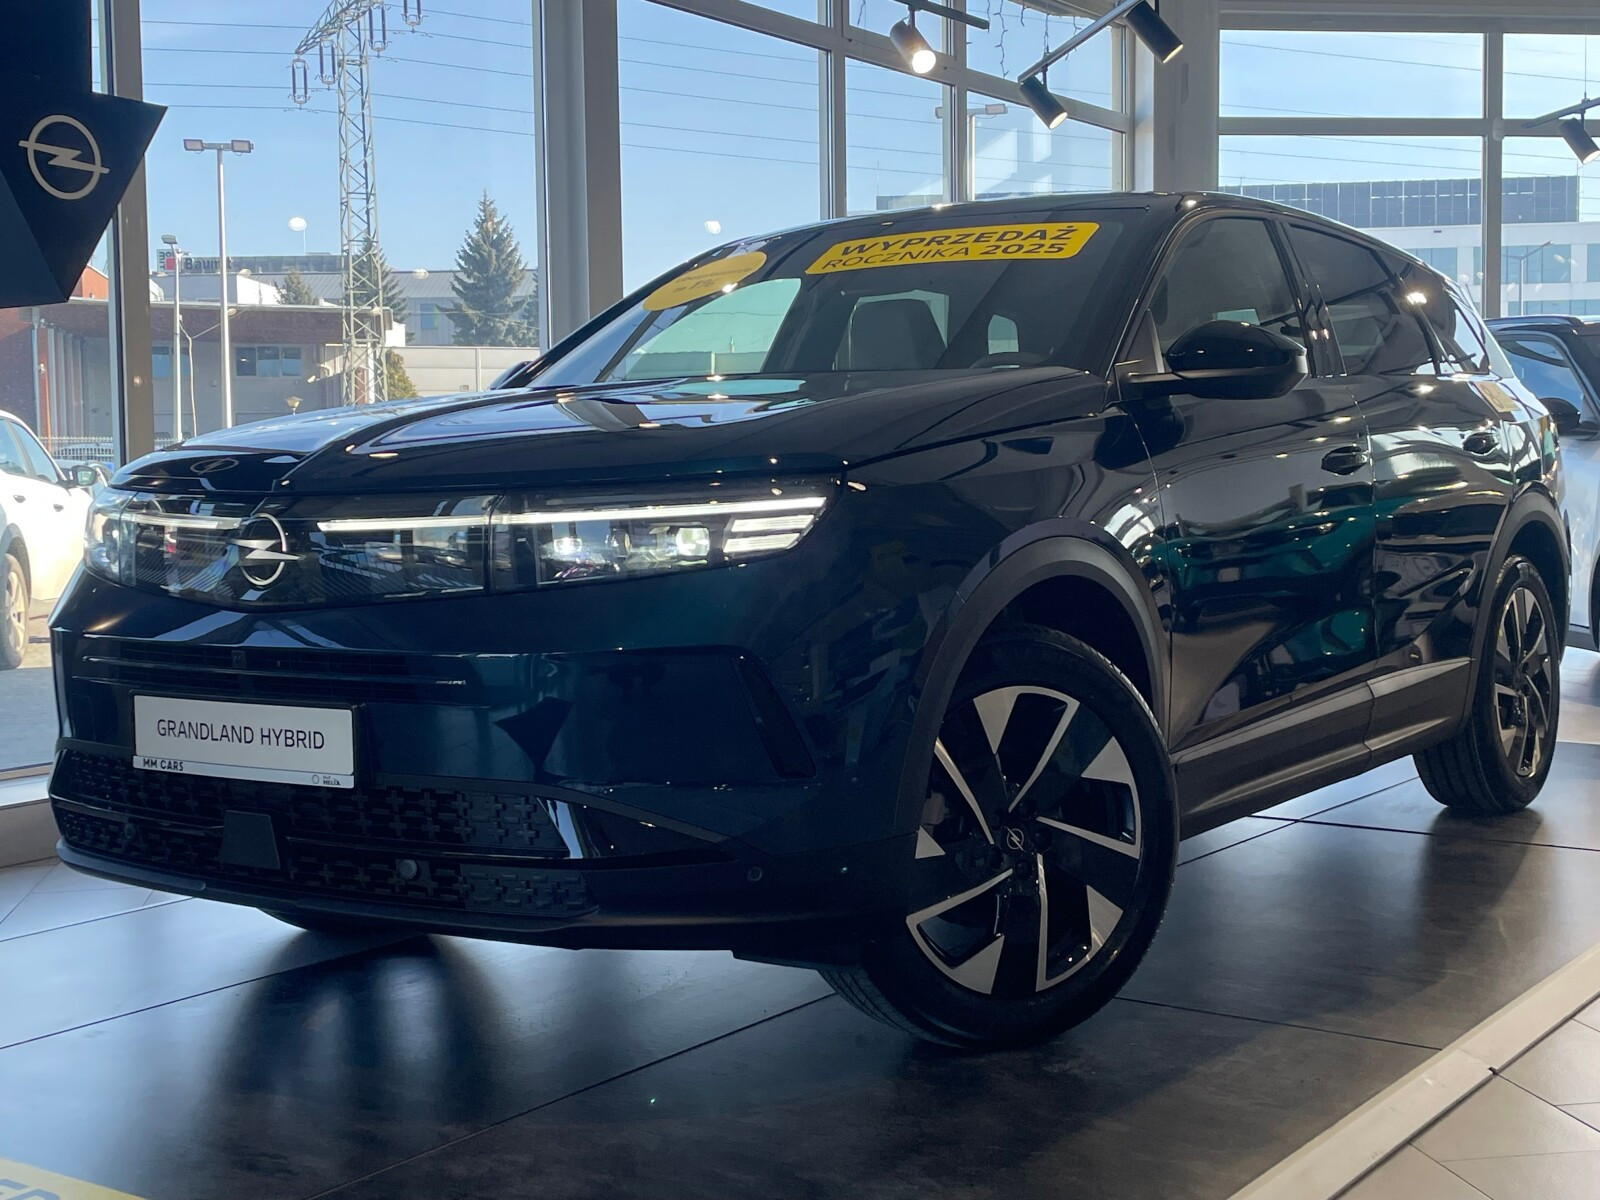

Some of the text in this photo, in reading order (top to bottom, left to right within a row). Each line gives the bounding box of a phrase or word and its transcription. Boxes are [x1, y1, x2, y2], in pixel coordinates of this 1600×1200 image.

[841, 225, 1078, 256] WYPRZEDAŻ
[185, 257, 232, 270] Baumt
[821, 243, 1069, 270] ROCZNIKA 2025
[157, 718, 325, 750] GRANDLAND HYBRID
[142, 758, 184, 772] MM CARS
